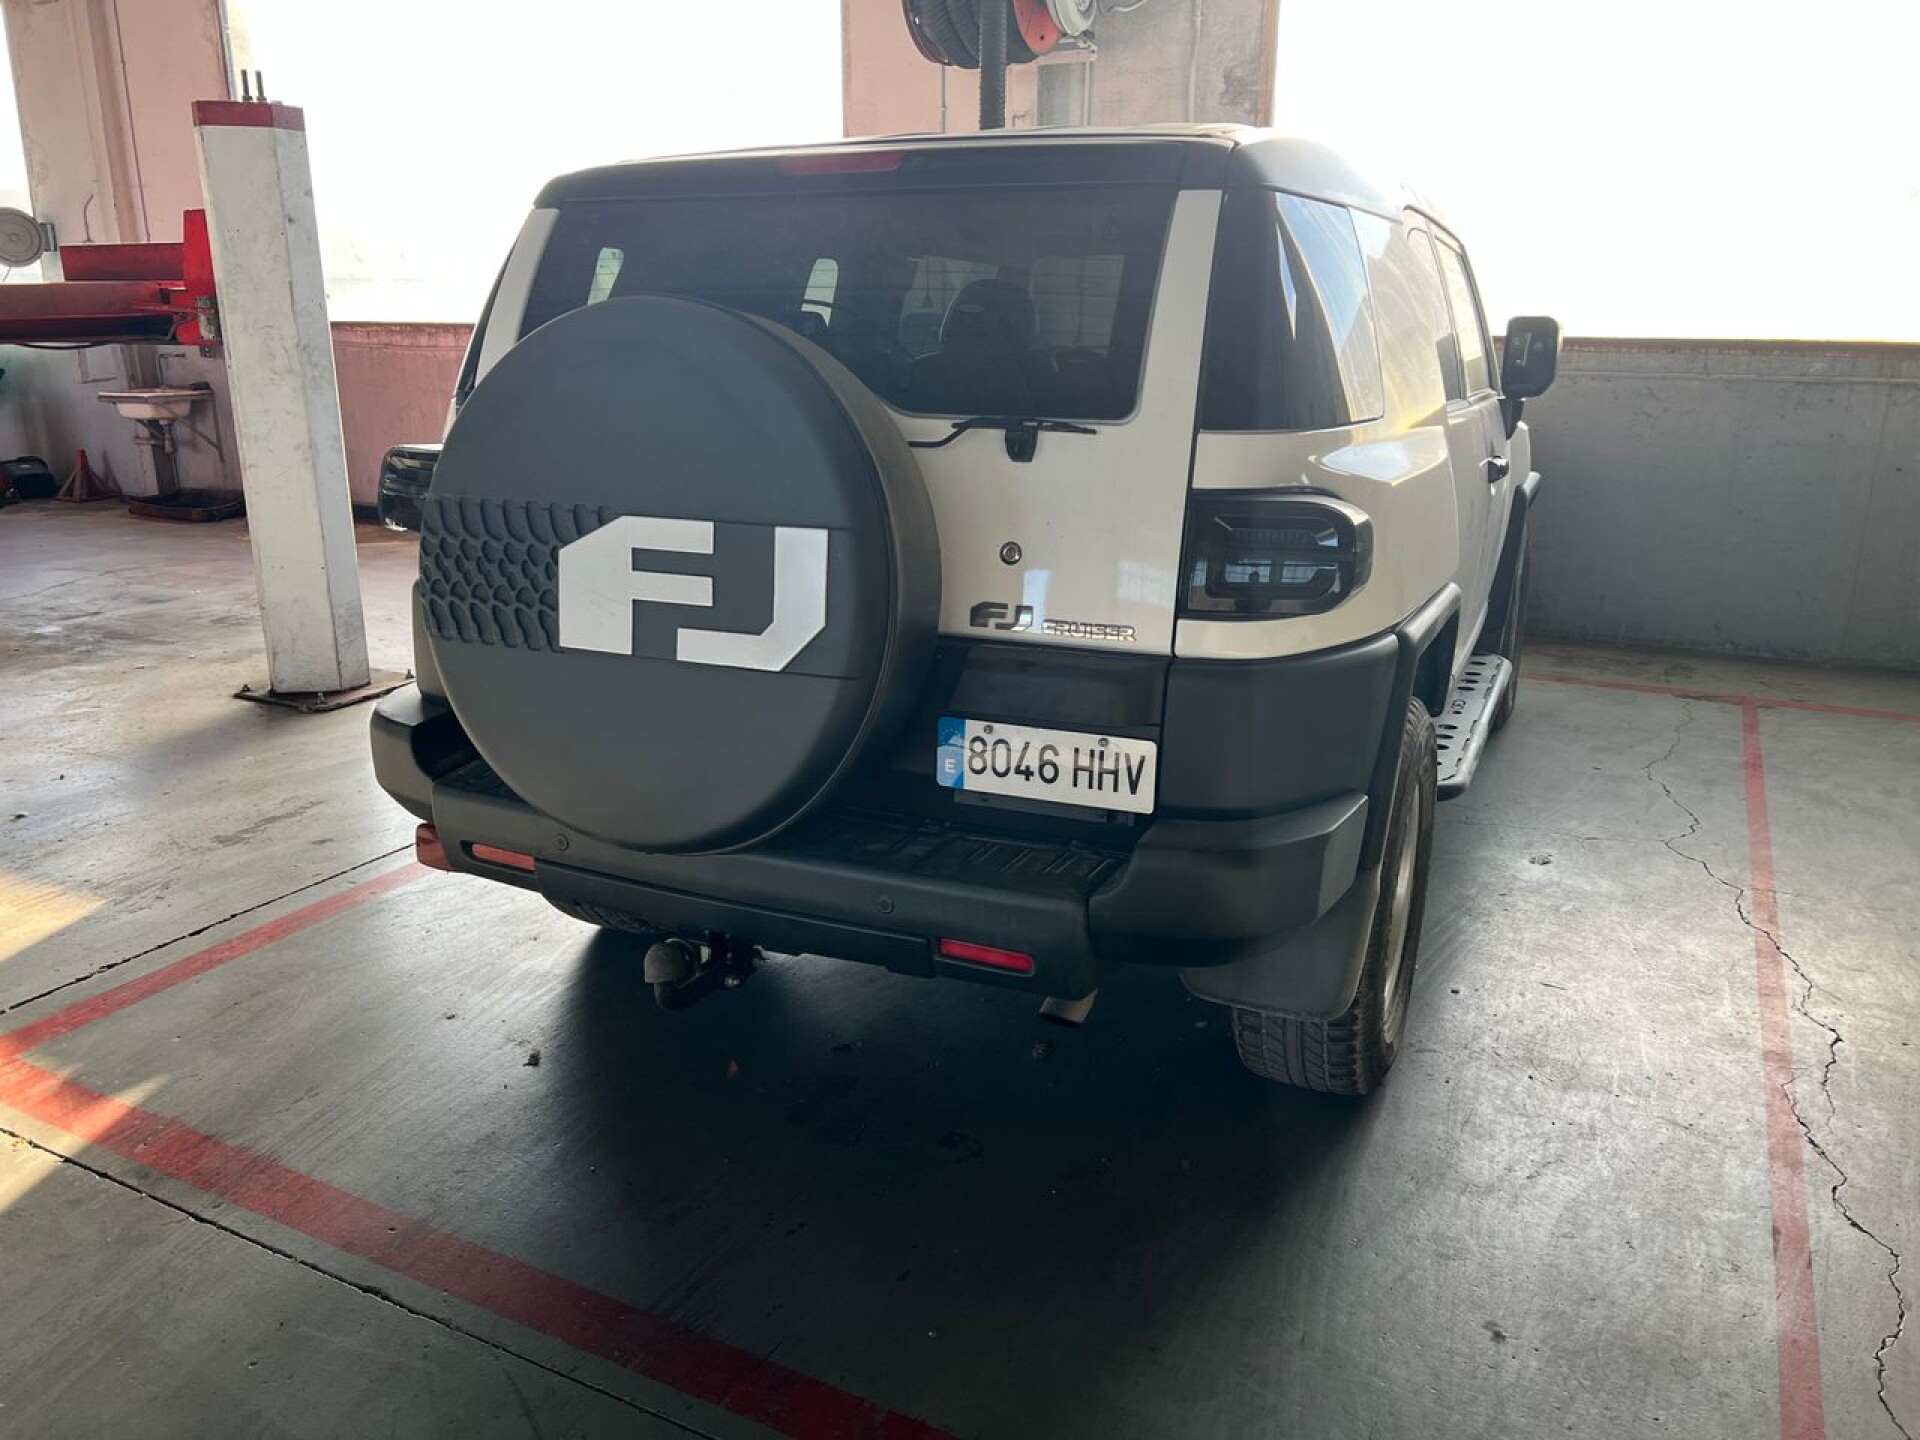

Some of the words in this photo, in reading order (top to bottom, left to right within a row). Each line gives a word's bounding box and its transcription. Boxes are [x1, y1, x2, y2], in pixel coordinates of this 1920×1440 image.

[559, 516, 828, 672] FJ
[970, 601, 1034, 631] FJ
[1042, 619, 1137, 642] CRUISER
[944, 758, 956, 773] E
[968, 735, 1060, 784] 8046
[1072, 747, 1147, 795] HHV
